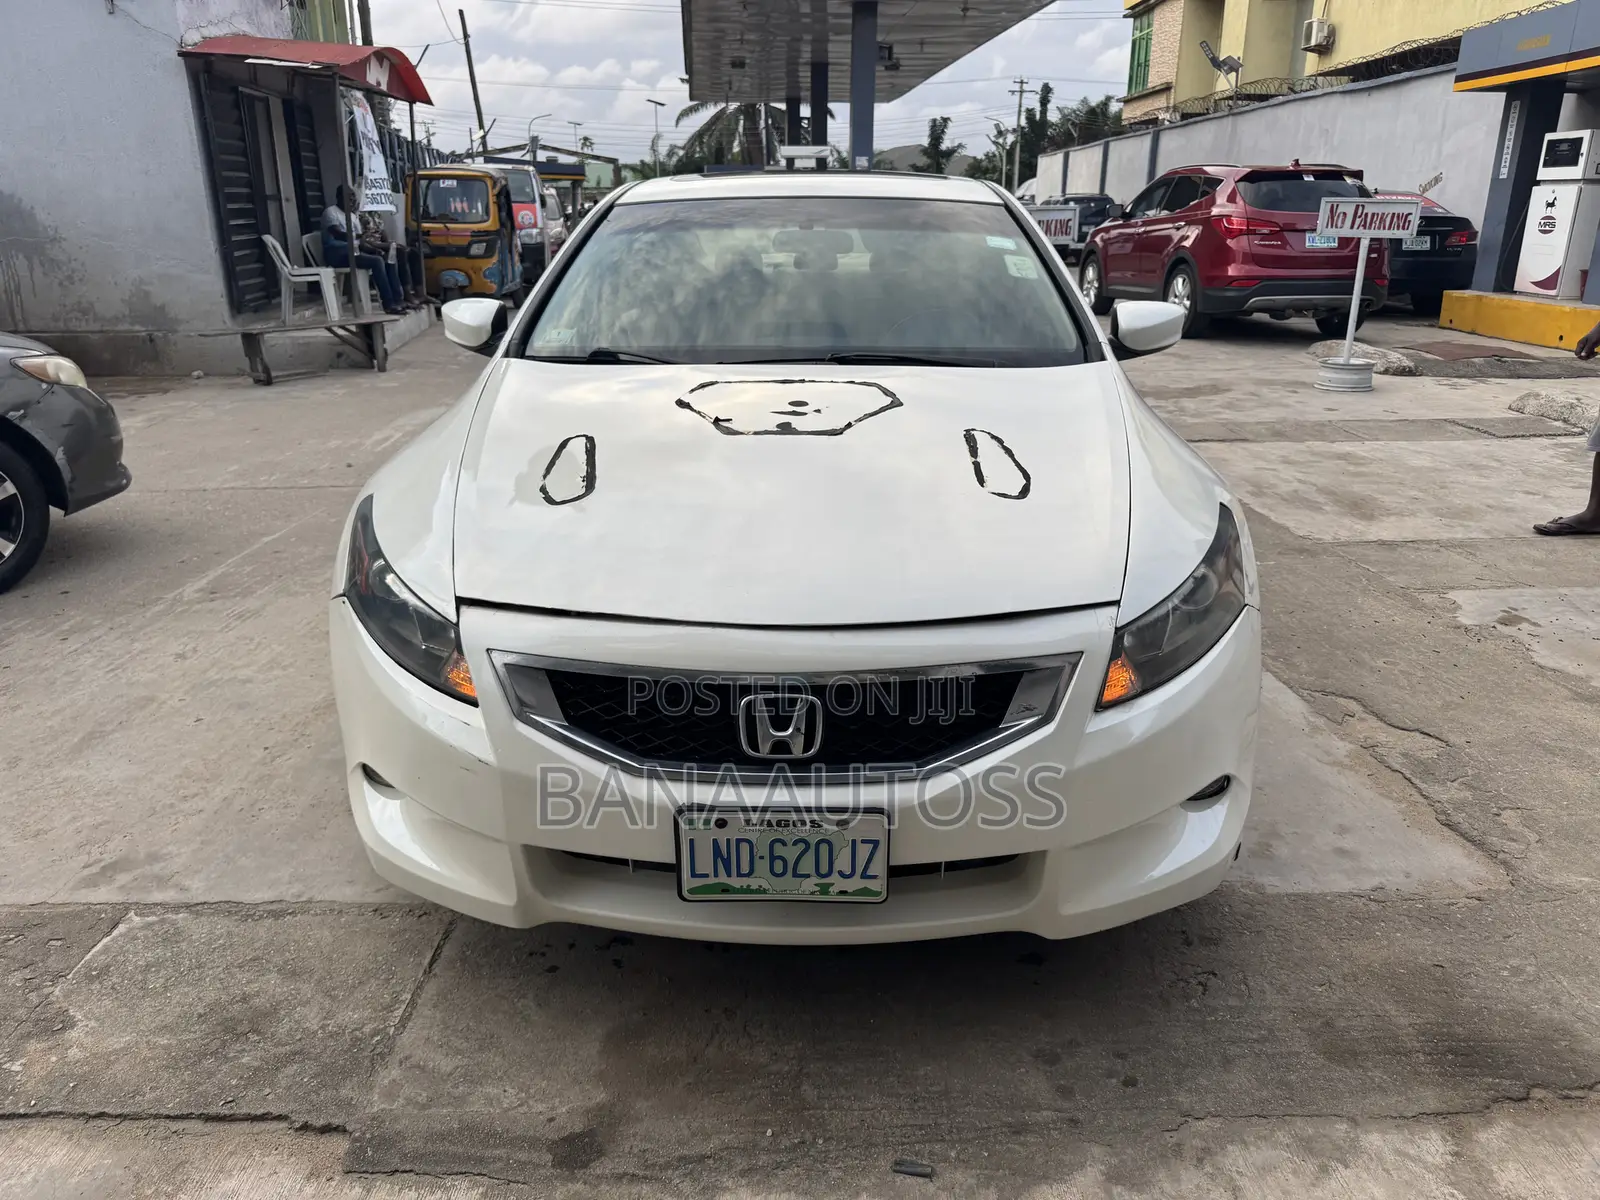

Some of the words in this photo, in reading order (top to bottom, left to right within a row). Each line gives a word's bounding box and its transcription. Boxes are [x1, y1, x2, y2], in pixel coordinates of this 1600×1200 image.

[1349, 203, 1413, 231] PARKING
[1537, 221, 1557, 229] MRS
[743, 818, 824, 829] LAGOS
[688, 837, 881, 880] LND-620JZ
